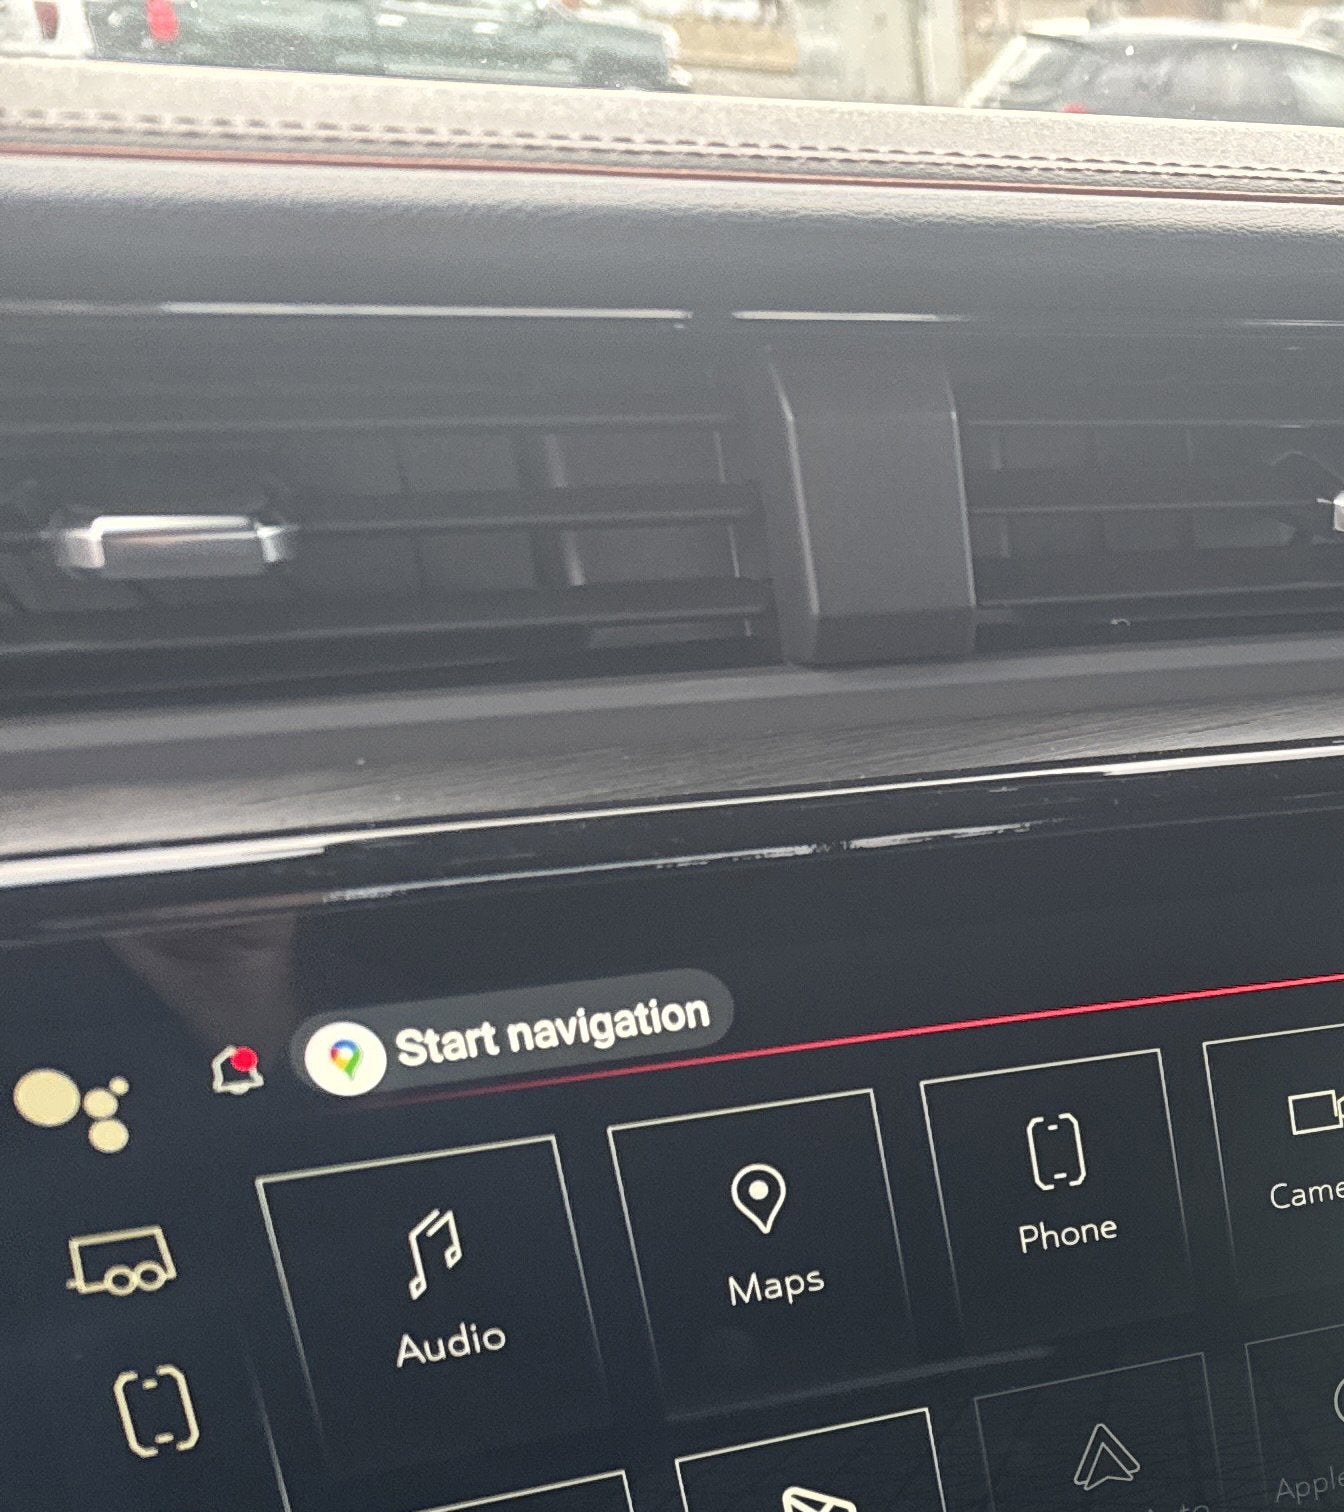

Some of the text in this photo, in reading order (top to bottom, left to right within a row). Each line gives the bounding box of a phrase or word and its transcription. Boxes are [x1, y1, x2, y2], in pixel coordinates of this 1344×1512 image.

[395, 998, 711, 1068] Start navigation
[1018, 1215, 1119, 1254] Phone
[727, 1266, 826, 1306] Maps
[395, 1321, 507, 1368] Audio
